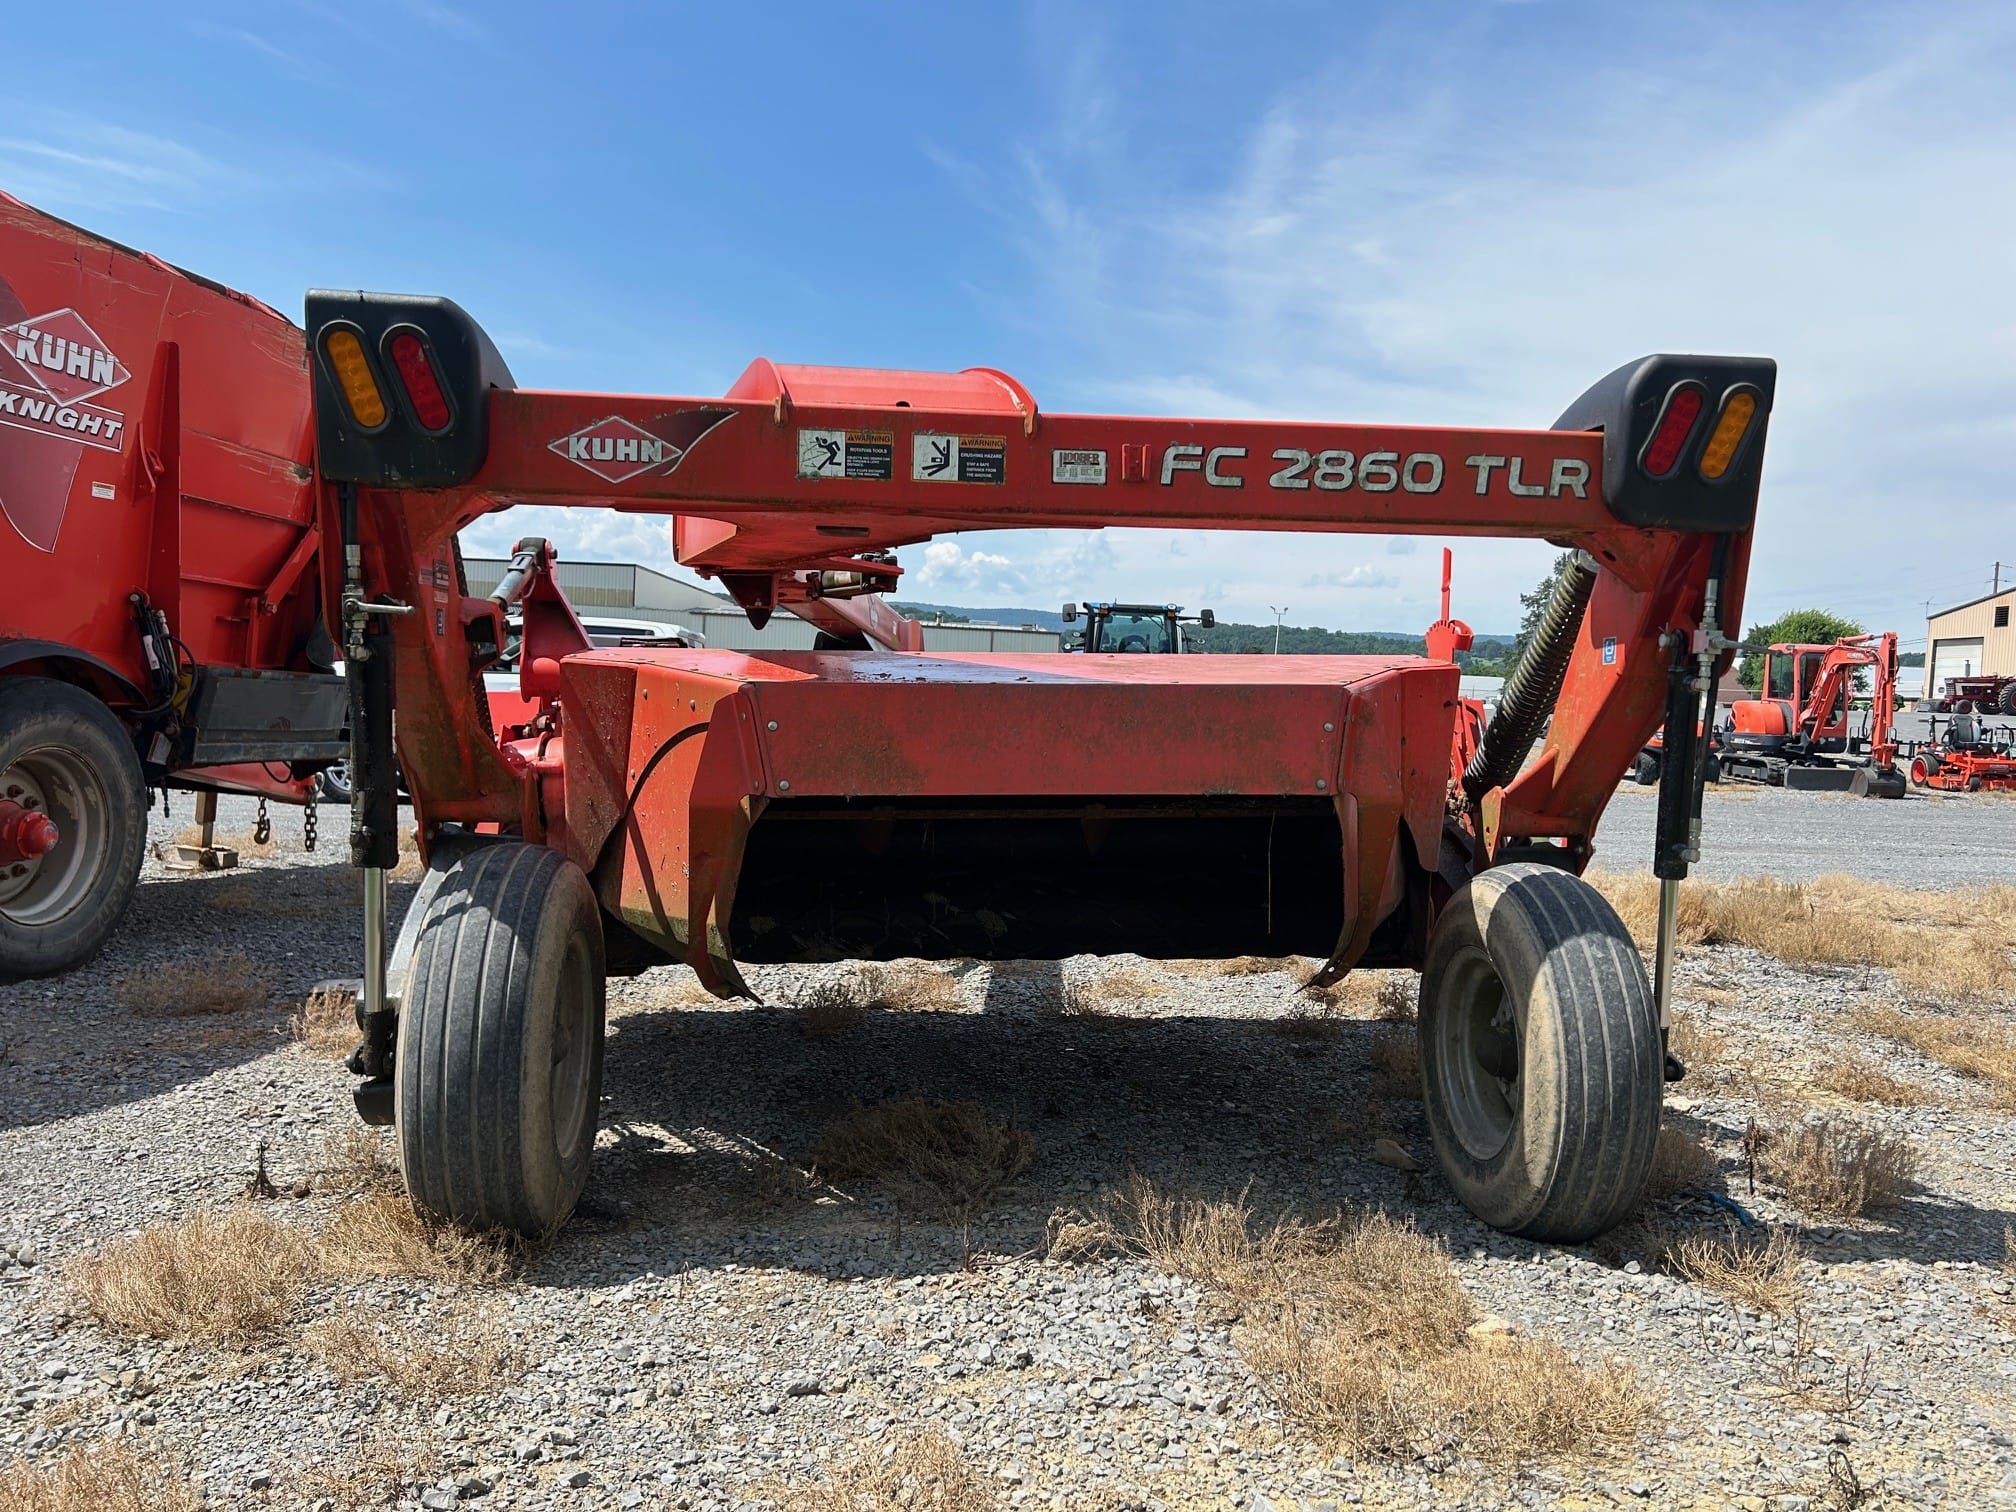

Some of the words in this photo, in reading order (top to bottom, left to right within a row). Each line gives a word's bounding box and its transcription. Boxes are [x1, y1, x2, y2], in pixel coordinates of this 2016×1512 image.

[15, 324, 116, 387] KUHN
[0, 390, 123, 440] KNIGHT
[568, 436, 663, 463] KUHN
[967, 439, 1003, 448] WARNING
[1160, 446, 1247, 486] FC
[1269, 449, 1443, 494] 2860
[1464, 455, 1590, 499] TLR
